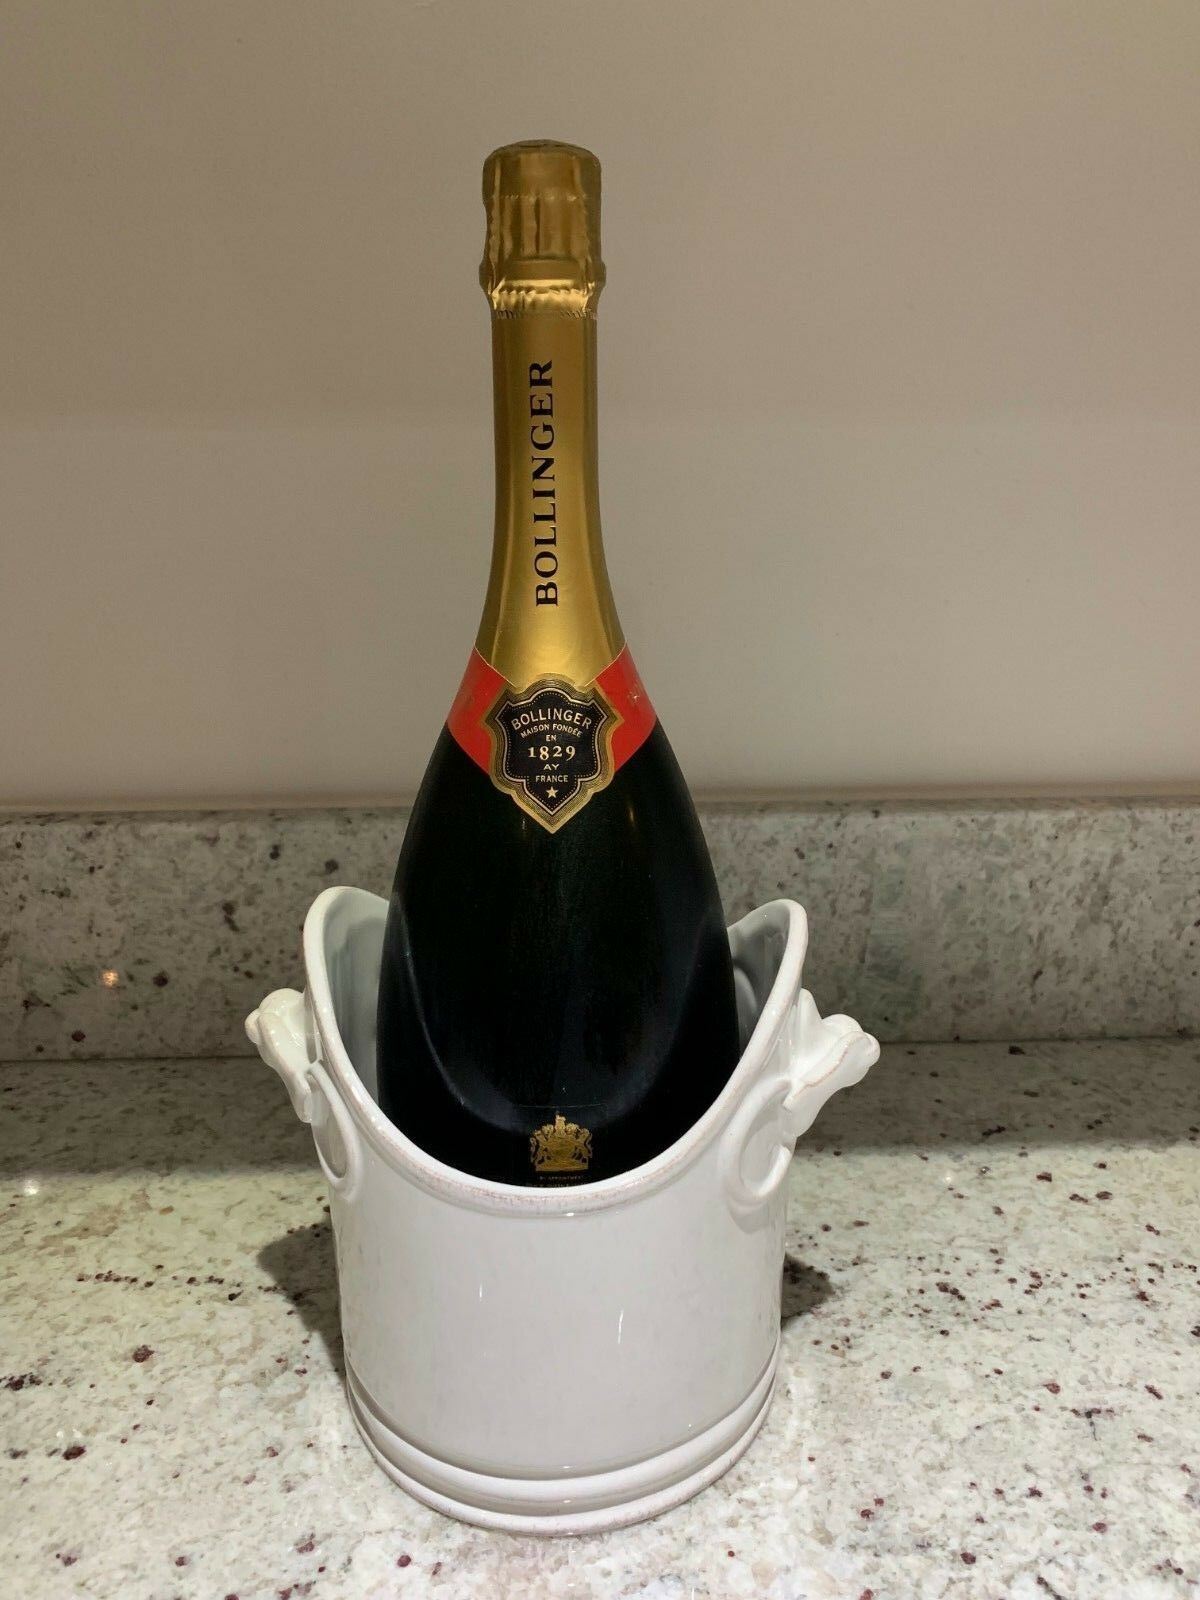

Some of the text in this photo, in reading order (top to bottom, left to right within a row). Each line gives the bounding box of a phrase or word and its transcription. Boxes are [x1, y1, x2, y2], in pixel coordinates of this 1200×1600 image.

[529, 360, 558, 607] BOLLINGER
[511, 708, 592, 730] BOLLINGER
[520, 723, 583, 738] MAISON FONDÉE
[545, 734, 557, 742] EN
[527, 745, 576, 761] 1829
[535, 775, 569, 783] FRANCE
